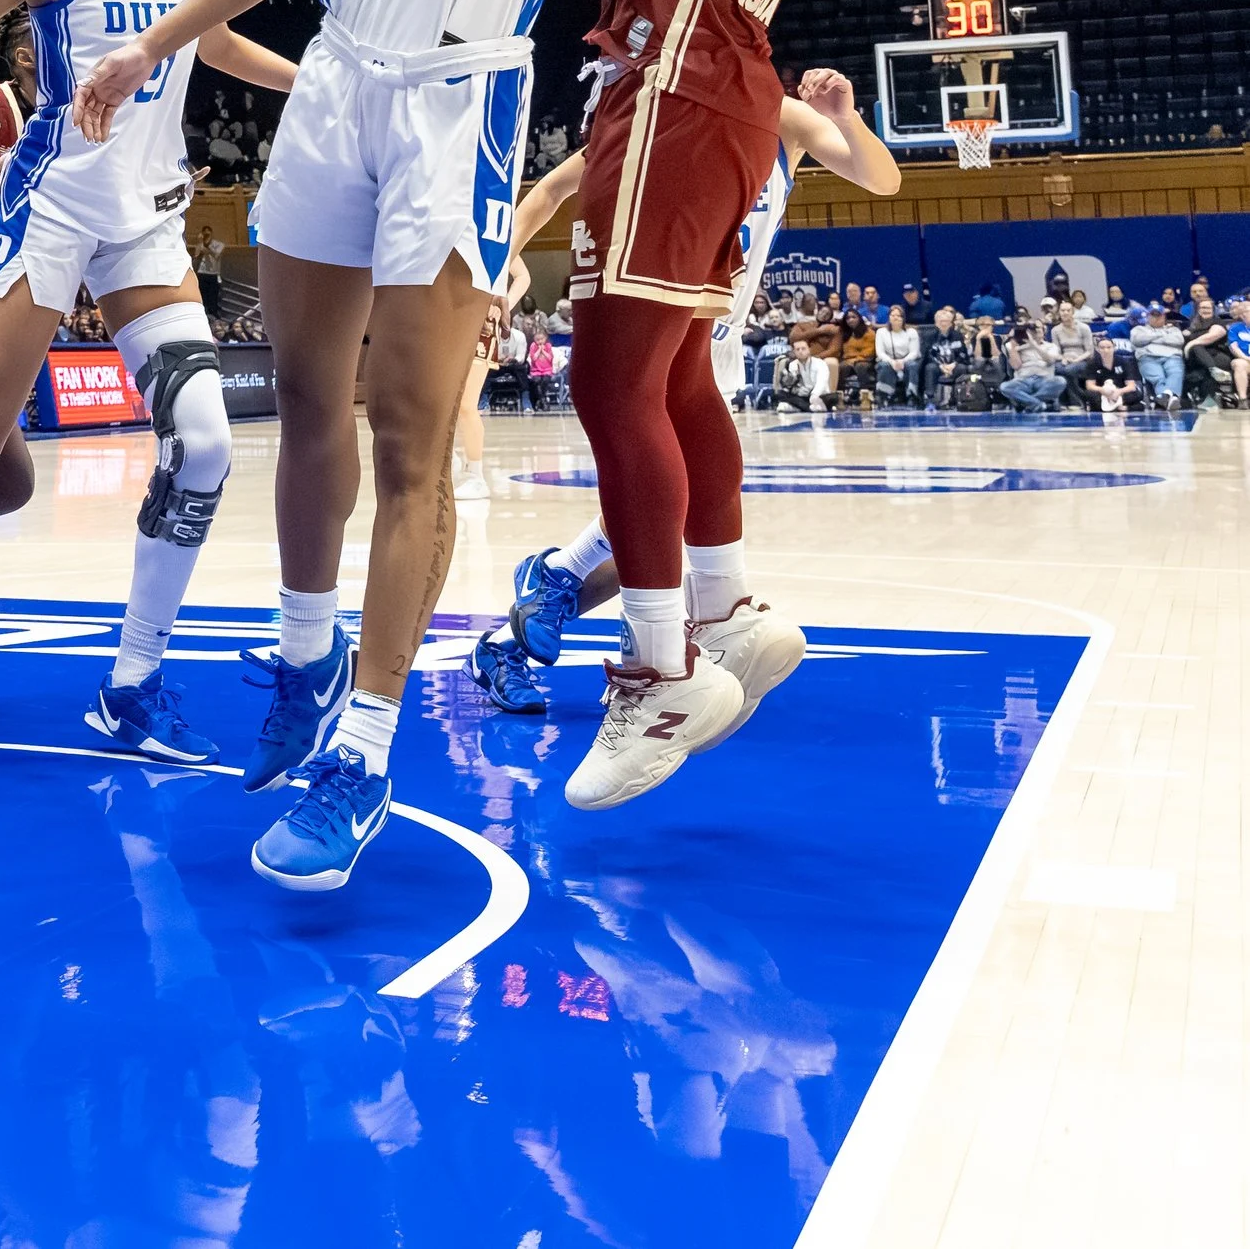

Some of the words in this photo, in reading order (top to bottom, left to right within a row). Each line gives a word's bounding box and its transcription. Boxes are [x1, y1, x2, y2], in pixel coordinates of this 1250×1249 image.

[946, 0, 993, 37] 30
[762, 270, 835, 289] SISTERHOOD
[55, 367, 83, 391] FAN
[83, 365, 122, 389] WORK
[60, 393, 69, 407] IS
[69, 391, 101, 407] THIRSTY
[100, 390, 125, 405] WORK
